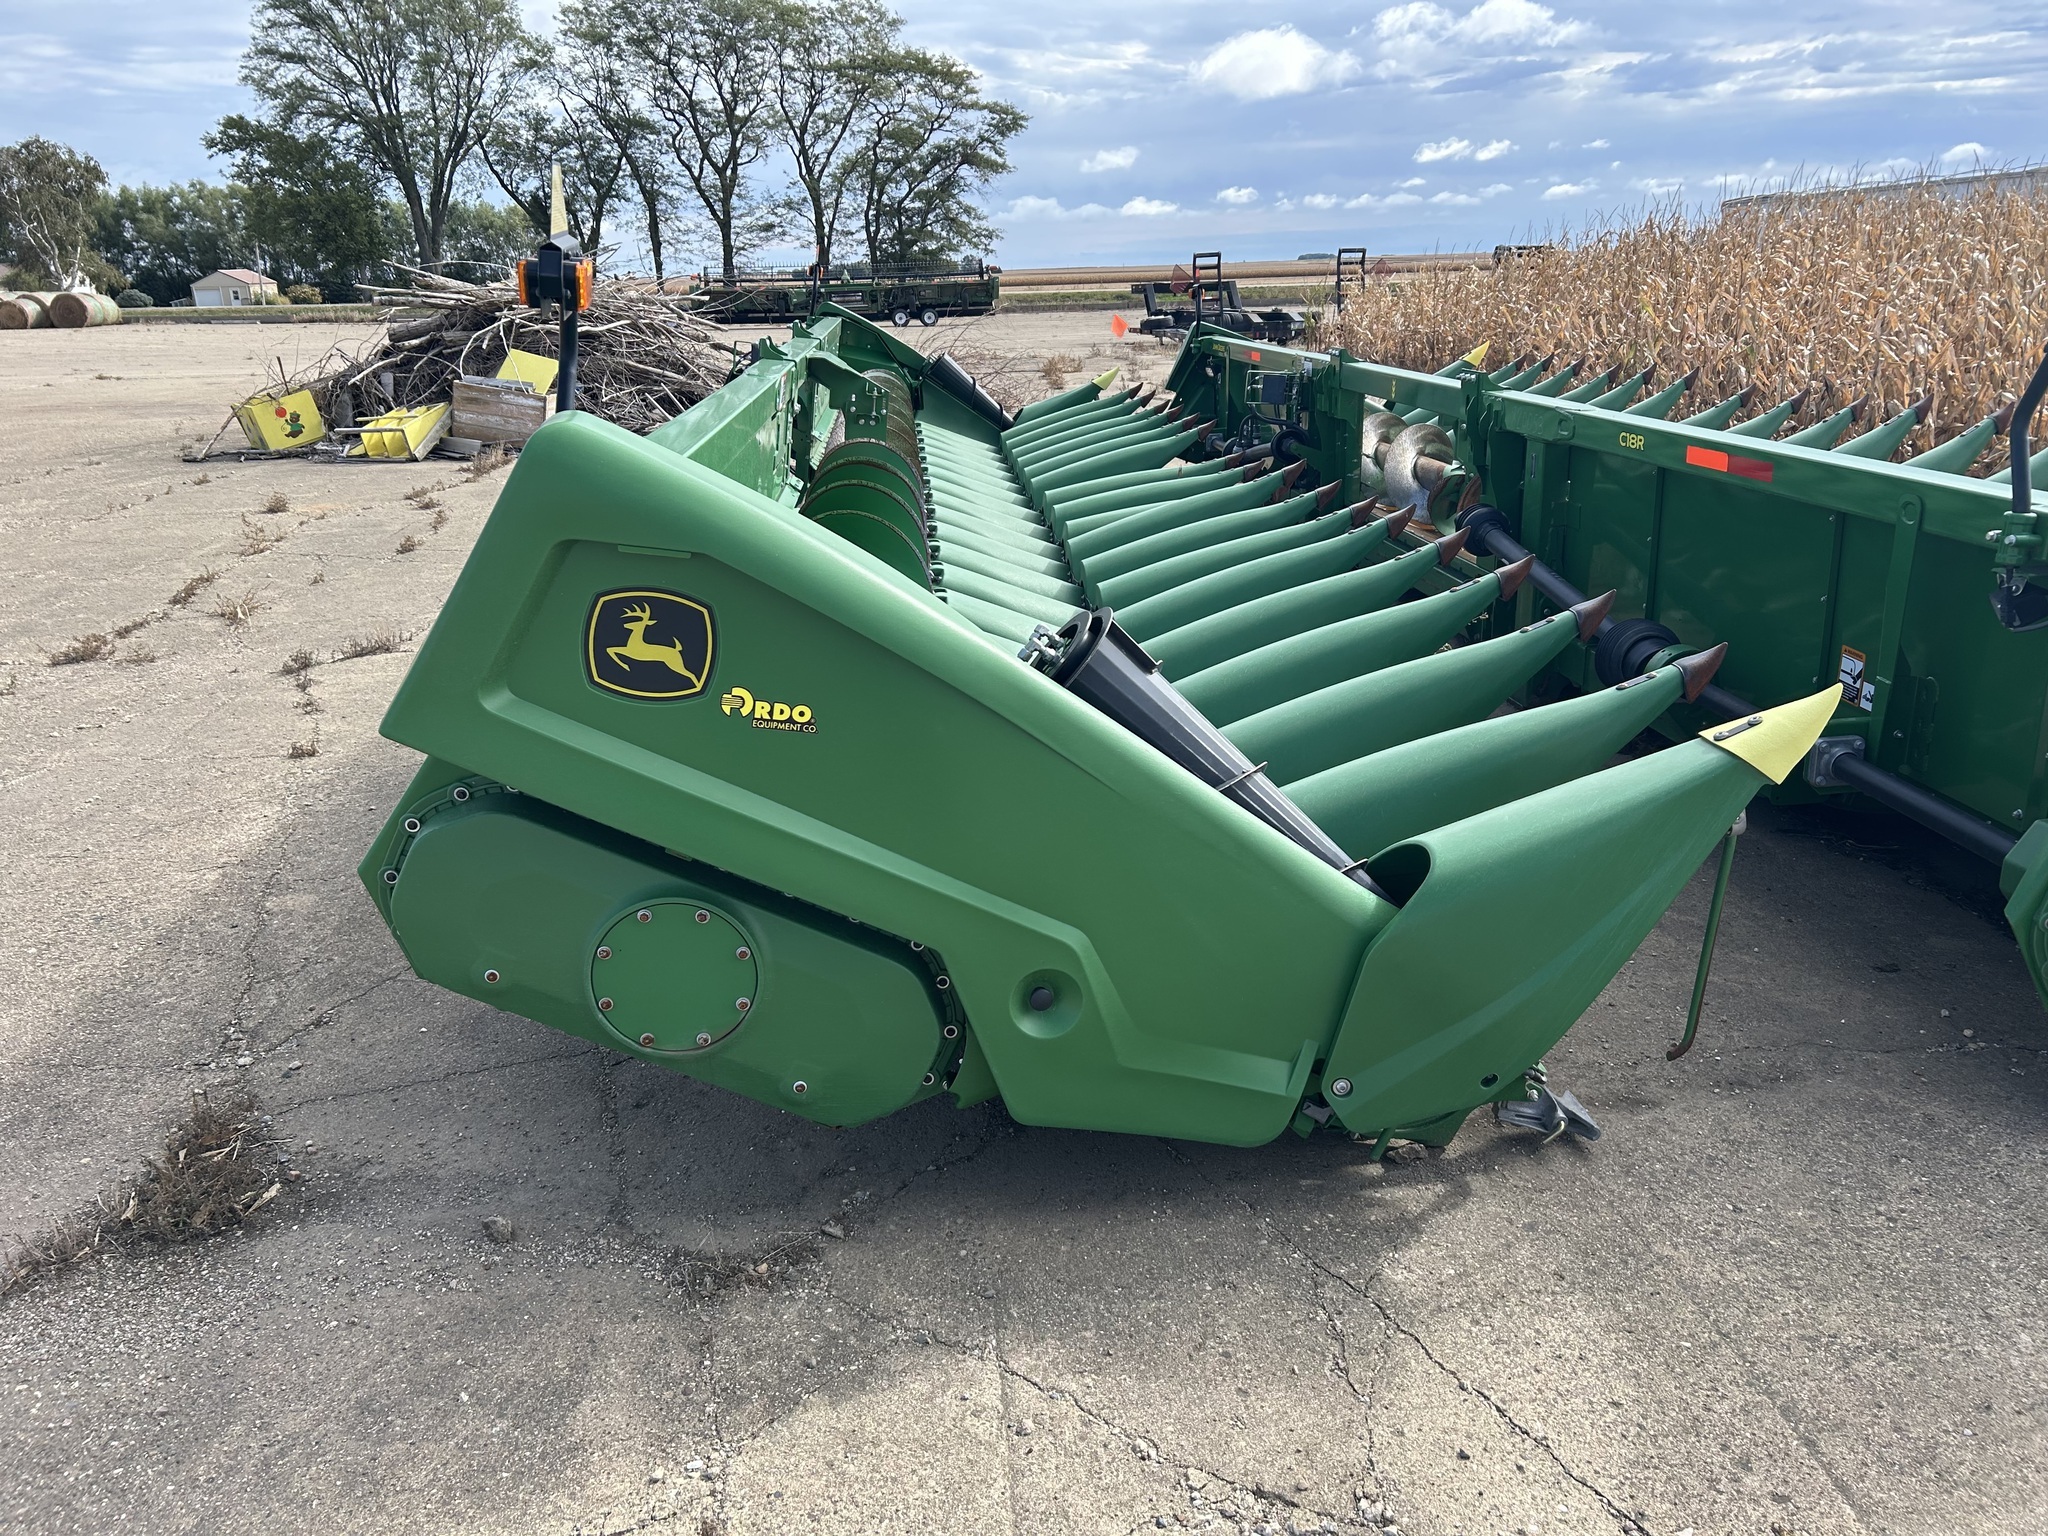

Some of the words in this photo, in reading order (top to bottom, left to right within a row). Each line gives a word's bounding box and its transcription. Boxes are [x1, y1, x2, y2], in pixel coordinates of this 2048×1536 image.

[1619, 431, 1645, 451] C18R
[752, 719, 801, 731] EQUIPMENT
[802, 724, 818, 733] CO.
